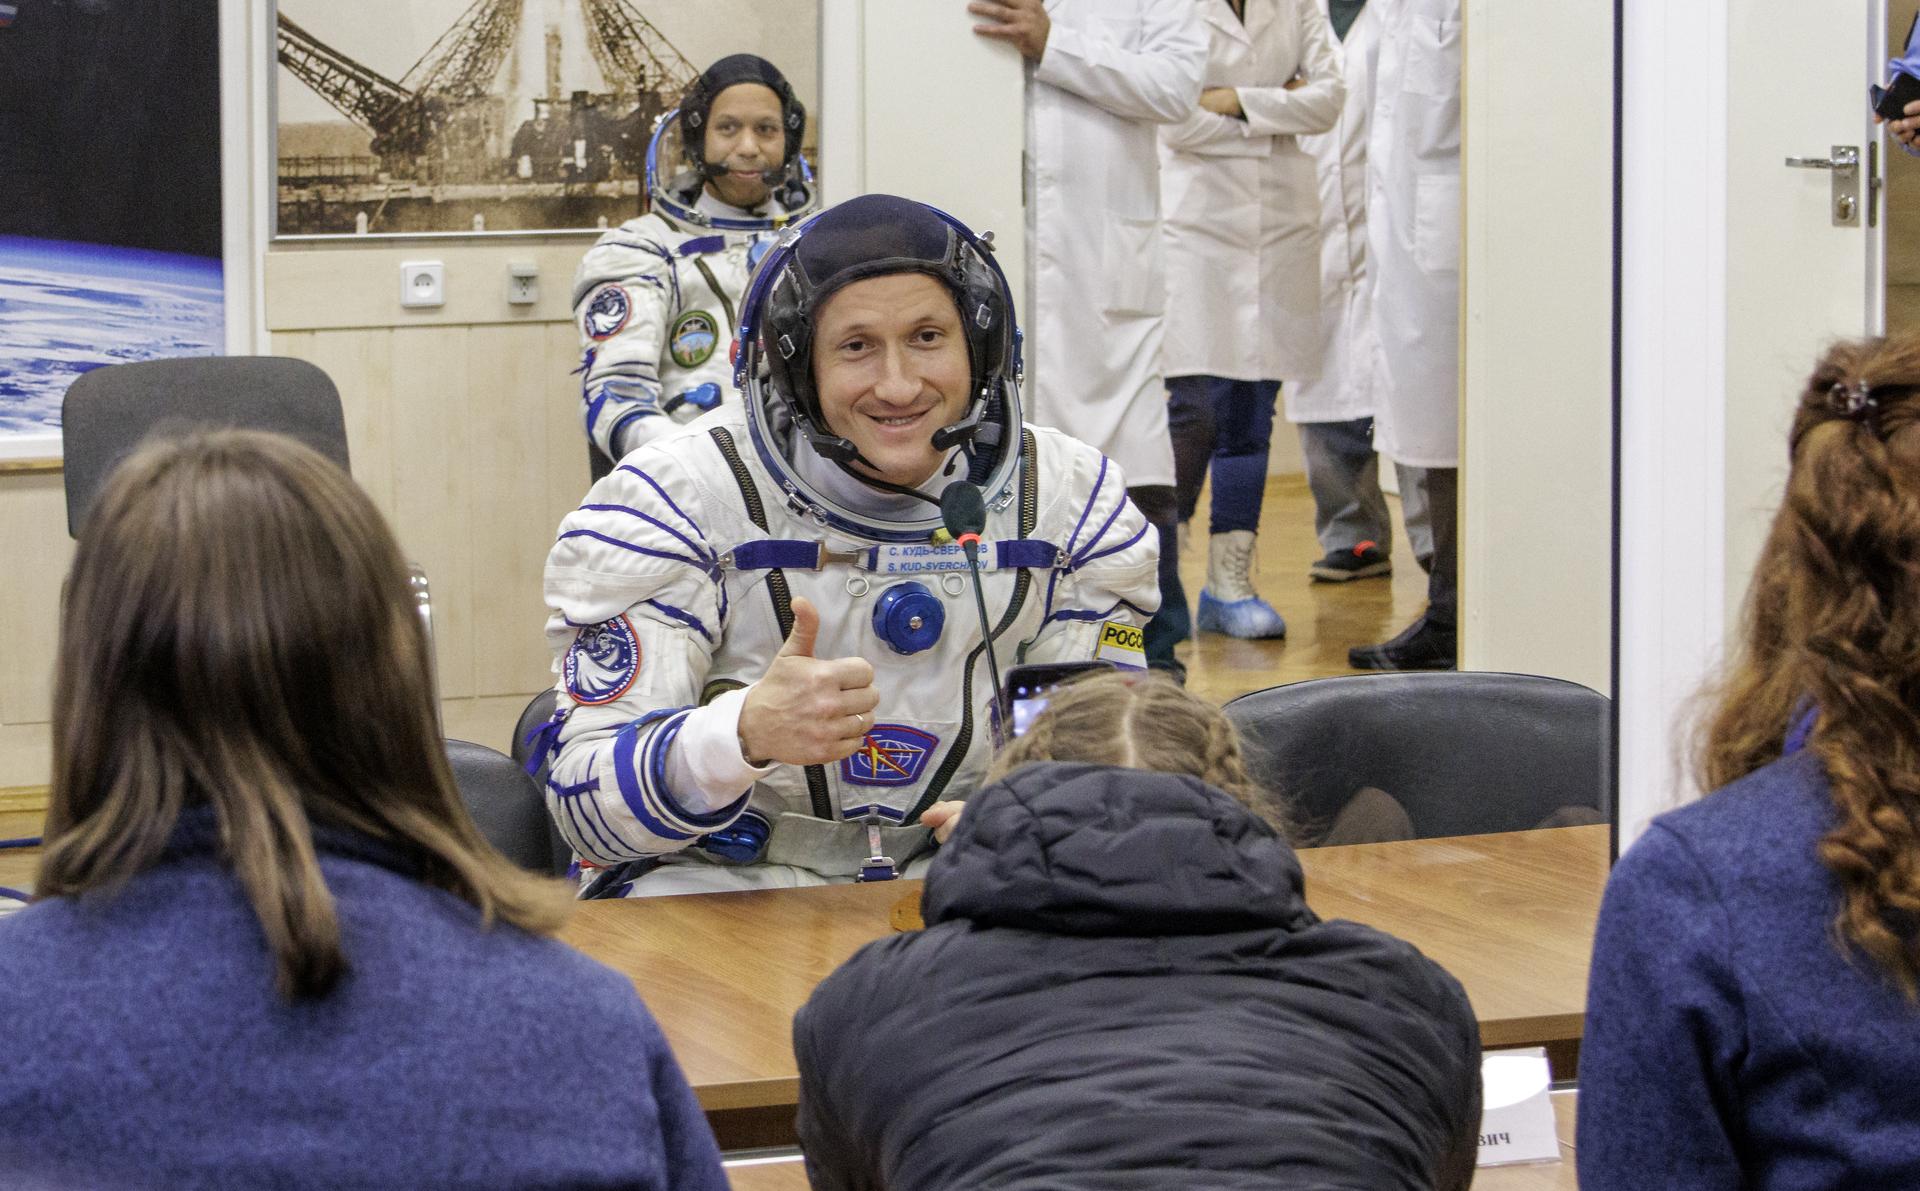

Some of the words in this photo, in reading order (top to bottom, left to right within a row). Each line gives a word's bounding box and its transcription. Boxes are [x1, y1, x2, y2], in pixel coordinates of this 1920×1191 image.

[902, 543, 989, 558] КУДЬ-СВЕРОВ
[888, 562, 898, 572] S.
[900, 559, 990, 573] KUD-SVERCHOV
